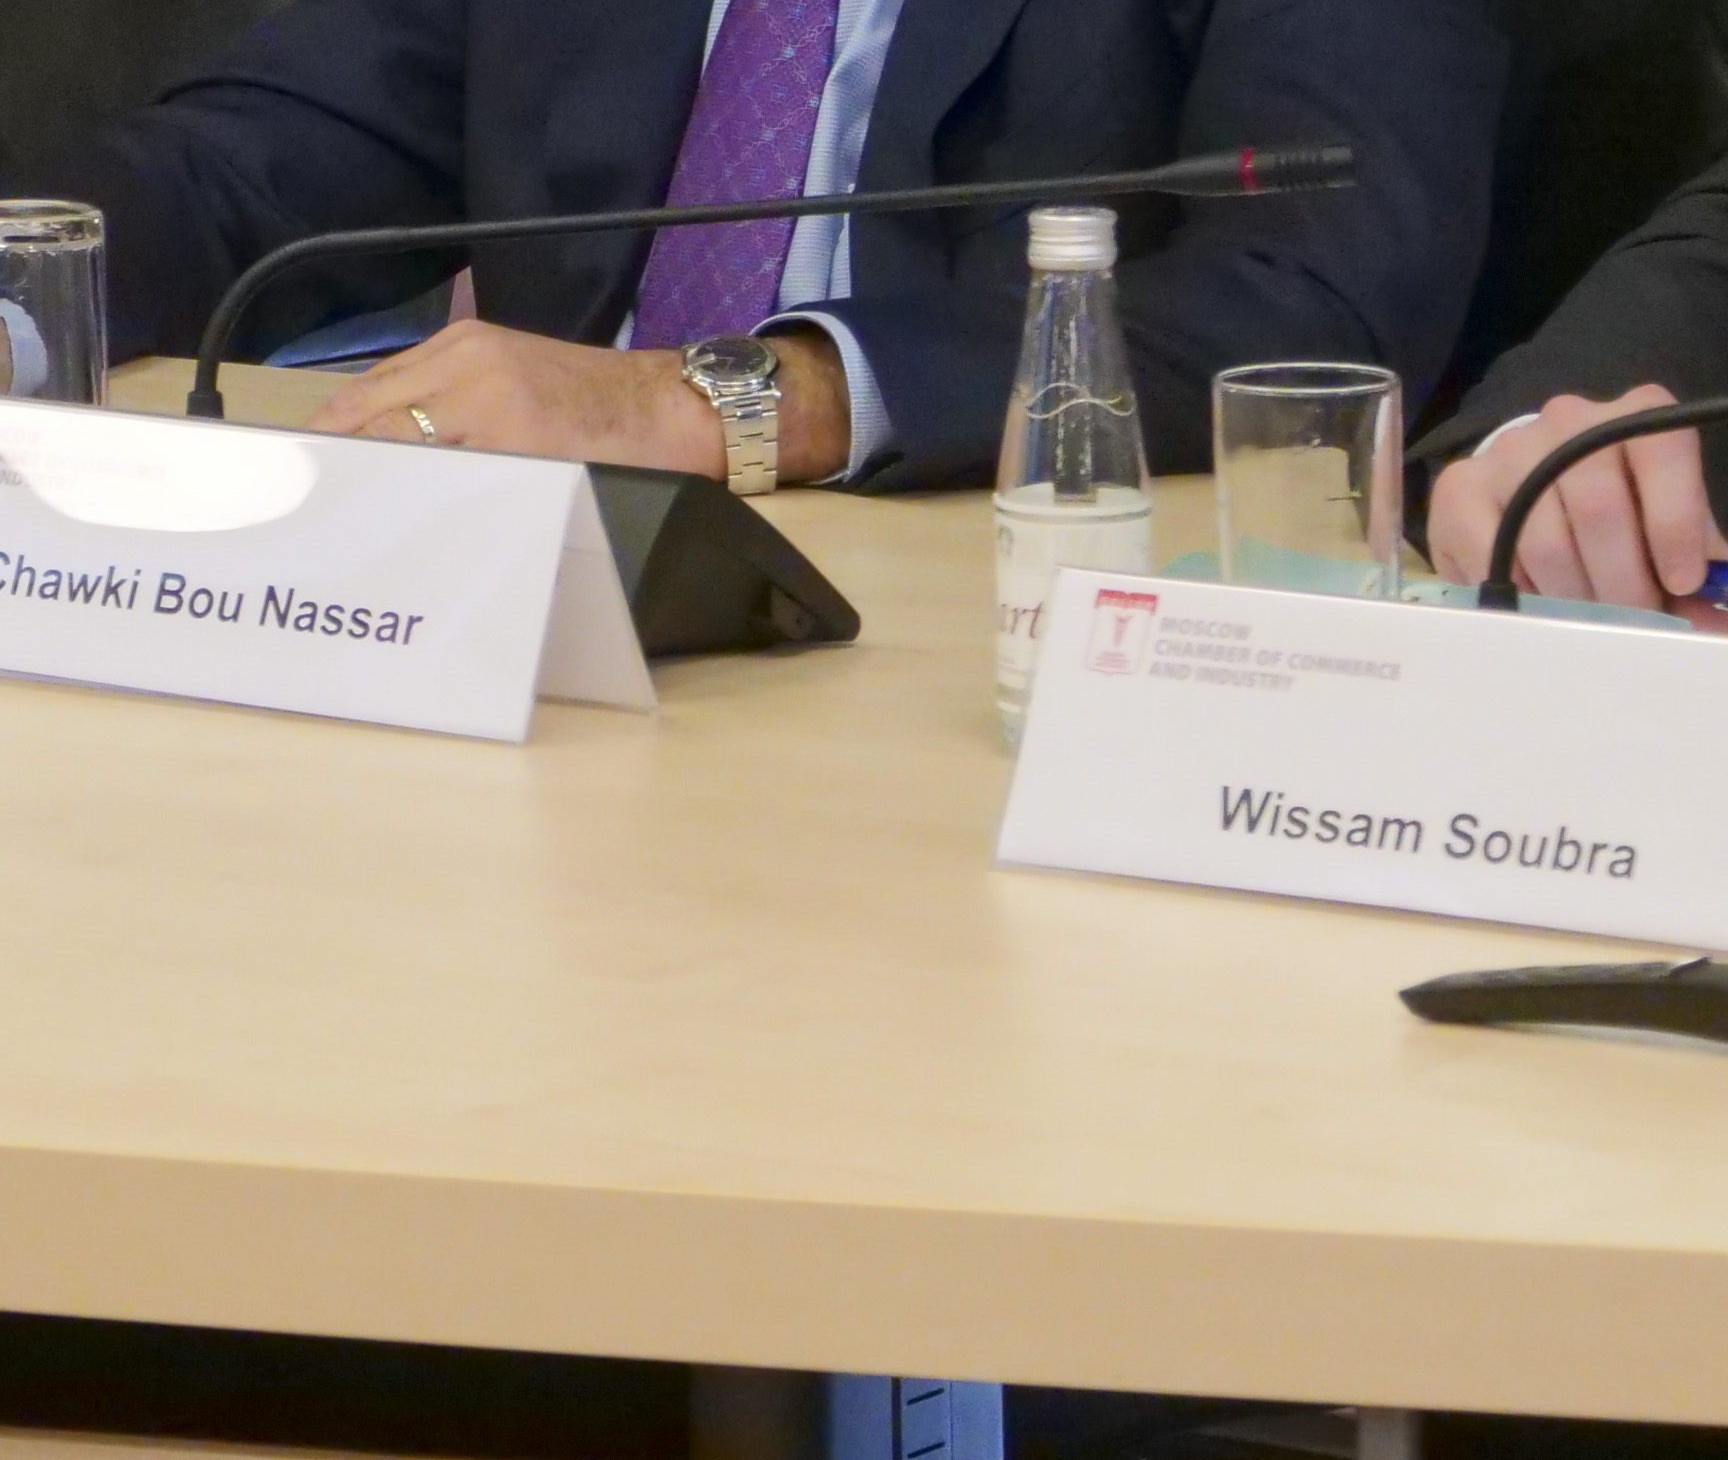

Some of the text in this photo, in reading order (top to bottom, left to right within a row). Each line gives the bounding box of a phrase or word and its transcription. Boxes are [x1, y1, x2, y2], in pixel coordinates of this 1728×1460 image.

[152, 571, 245, 624] Bou
[258, 584, 425, 646] Nassar
[1159, 616, 1253, 641] MOSCOW
[1148, 660, 1193, 681] AND
[1194, 665, 1295, 691] INDUSTRY
[1154, 638, 1251, 664] CHAMBER
[1255, 649, 1283, 666] OF
[1287, 652, 1402, 682] COMMERCE
[1221, 785, 1637, 879] Wissam Soubra
